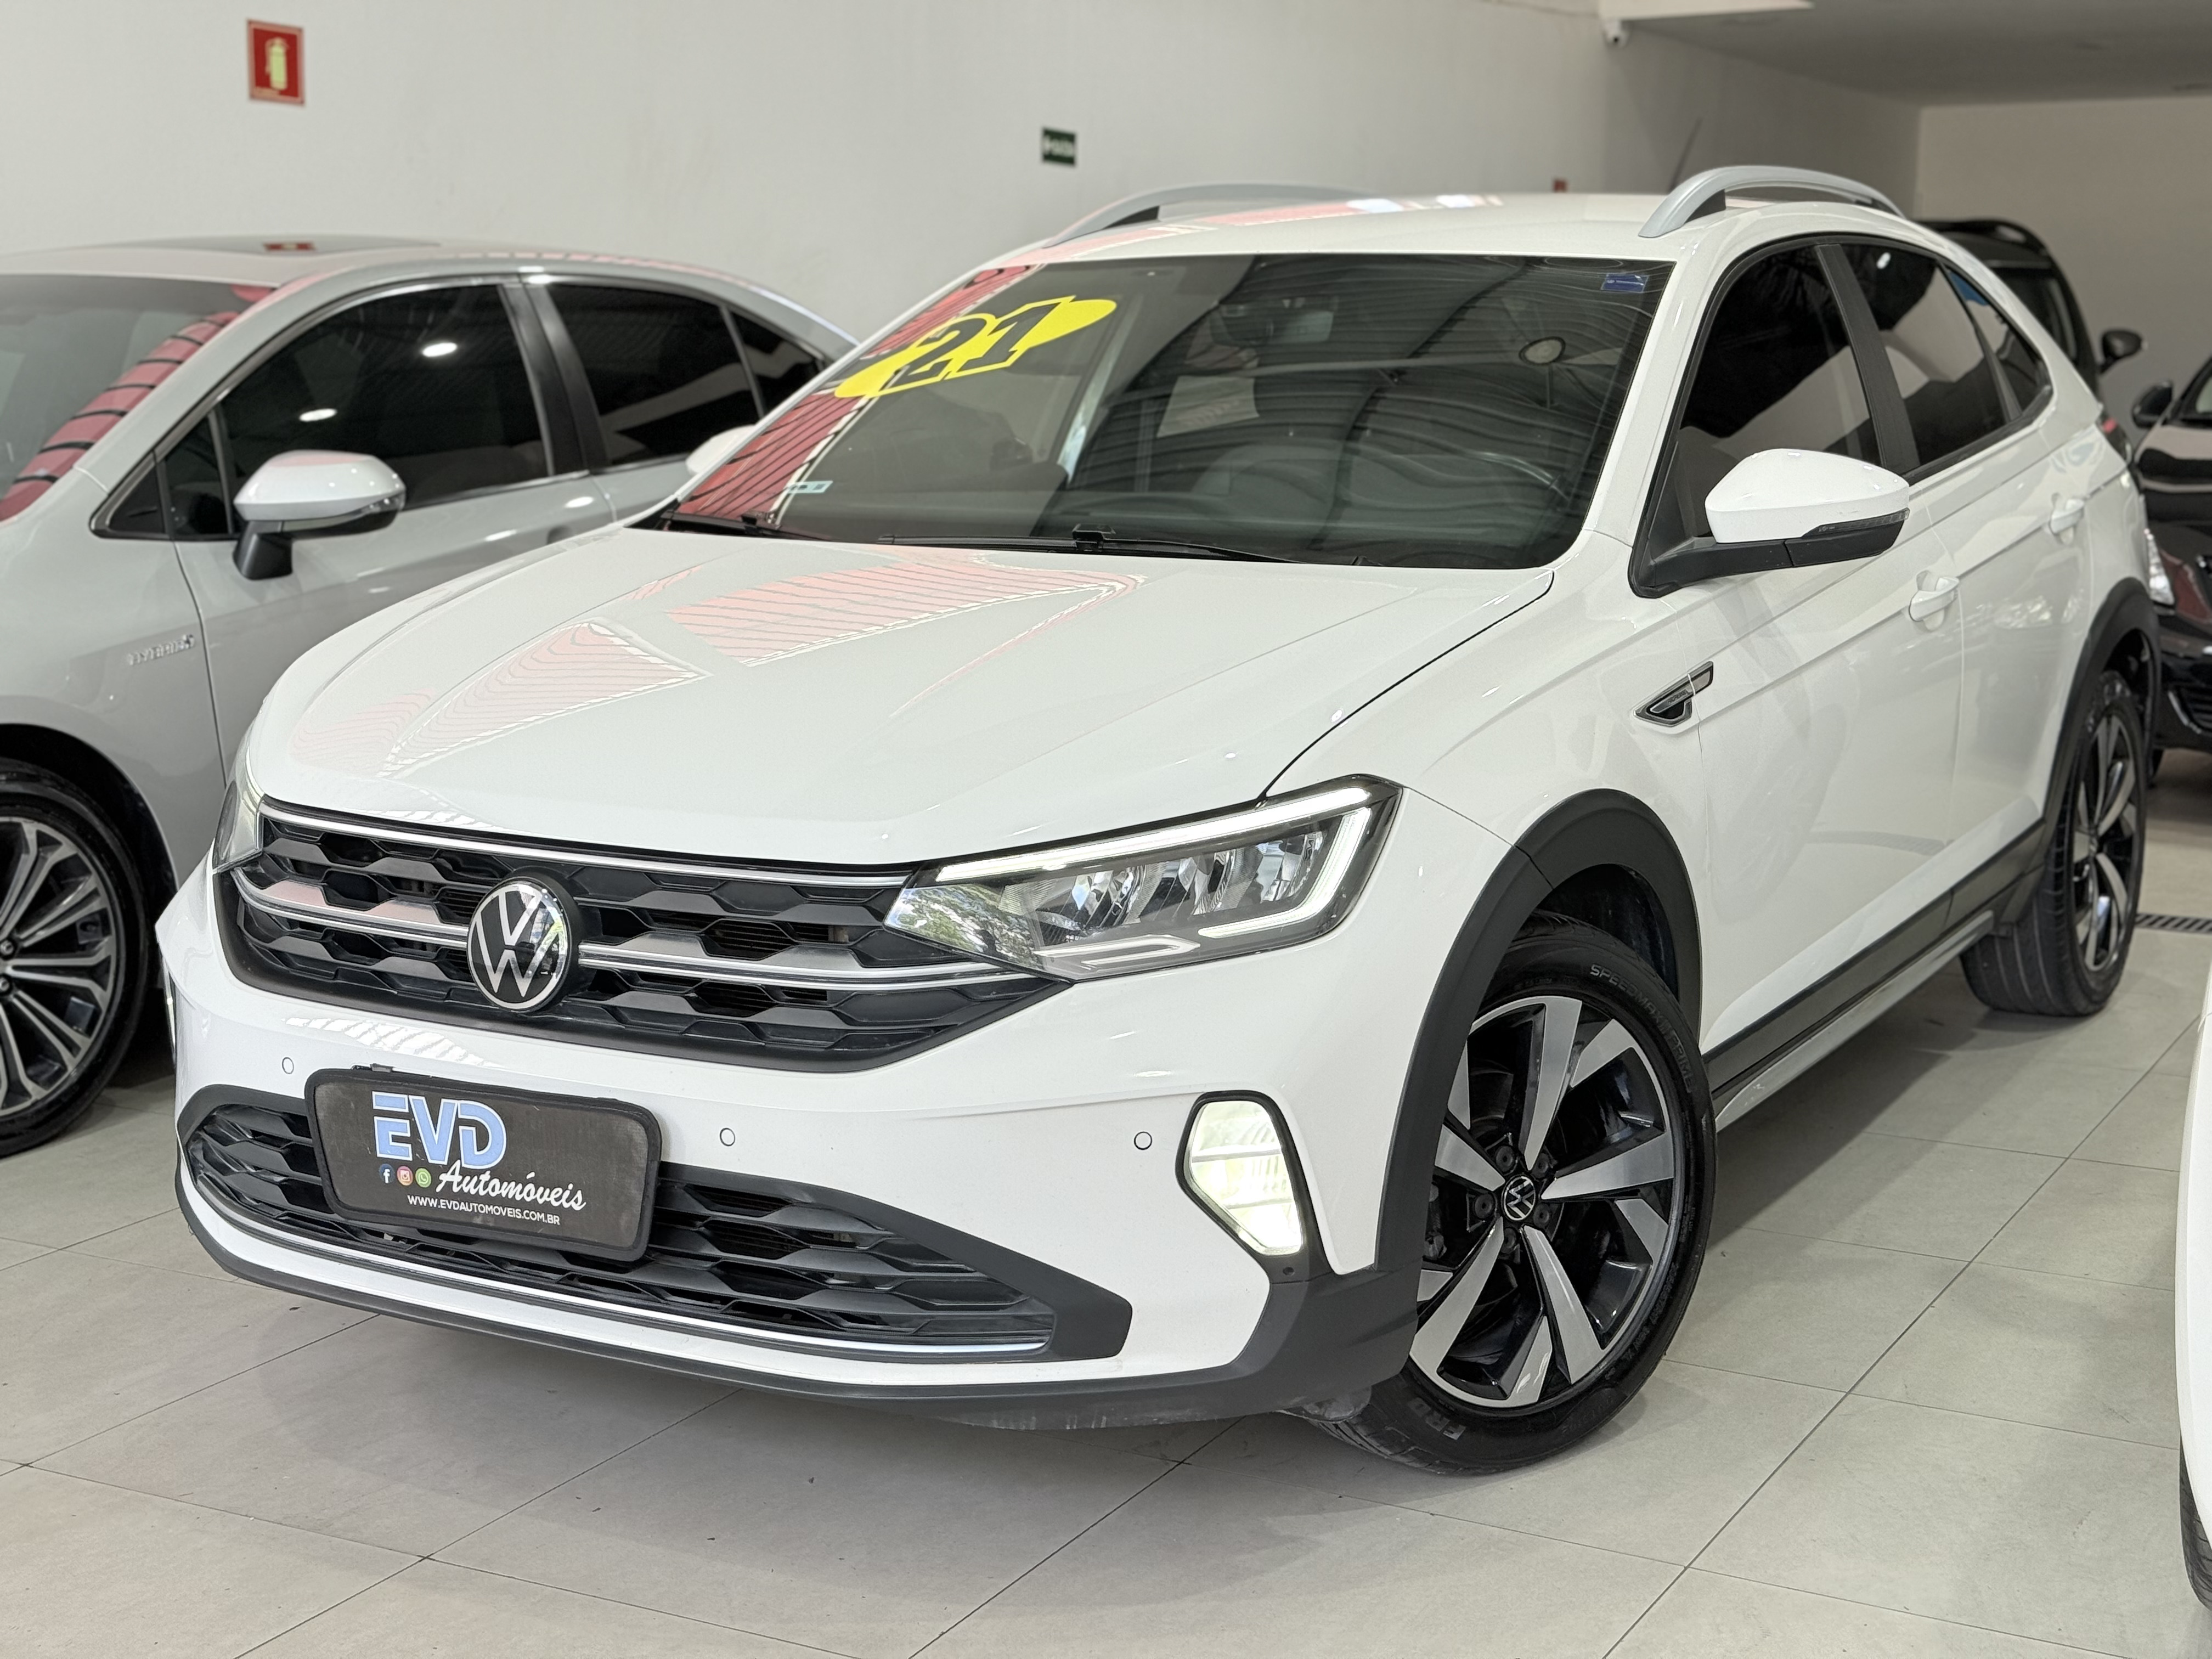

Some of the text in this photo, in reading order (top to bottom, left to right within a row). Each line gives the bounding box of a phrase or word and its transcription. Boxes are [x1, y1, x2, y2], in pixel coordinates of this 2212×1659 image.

[877, 300, 1064, 393] 21
[1590, 963, 1694, 1094] SPEEDMAX PRIME
[372, 1091, 507, 1170] EVD
[407, 1195, 561, 1226] WWW.EVDAUTOMOVEIS.COM.BR
[436, 1159, 586, 1211] Automóveis
